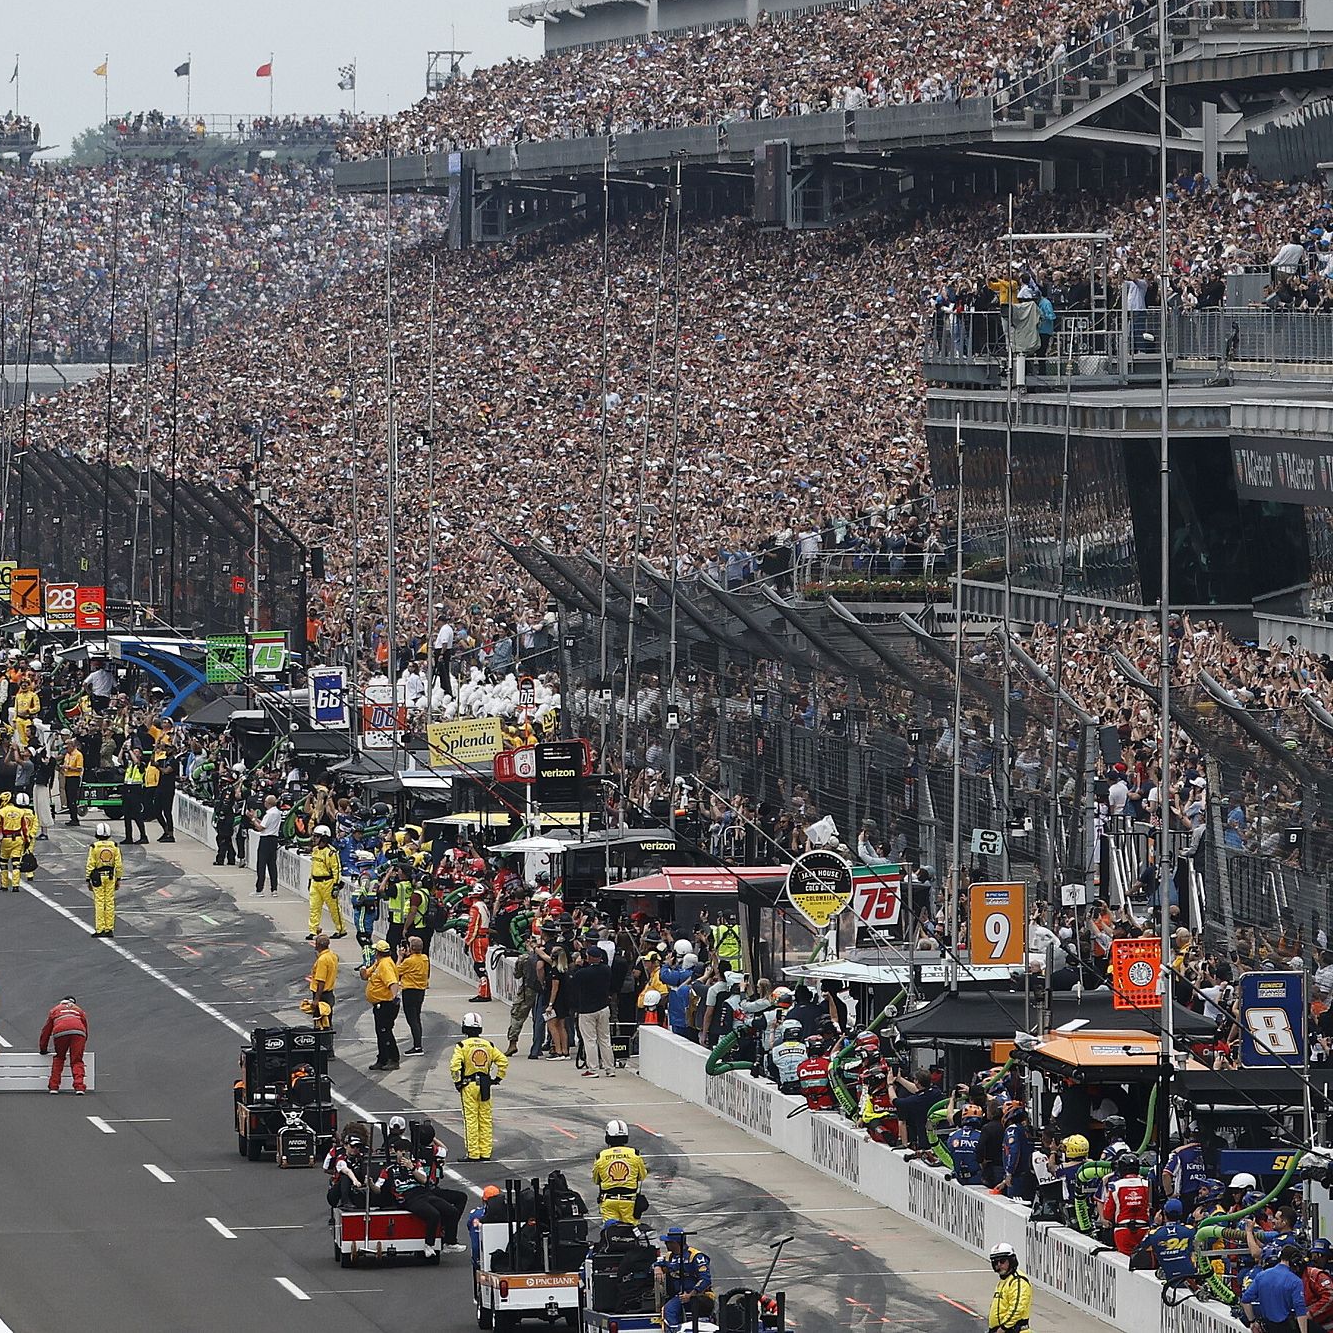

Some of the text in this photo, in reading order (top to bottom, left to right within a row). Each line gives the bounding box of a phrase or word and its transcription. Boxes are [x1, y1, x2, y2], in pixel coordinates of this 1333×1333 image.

[47, 588, 75, 610] 28
[937, 612, 990, 623] INDIAAPOLIS
[255, 646, 283, 668] 45
[317, 688, 341, 710] 66
[521, 688, 533, 704] 06
[439, 732, 495, 754] Splenda
[541, 768, 575, 778] verizon
[639, 841, 676, 851] verizon
[979, 830, 998, 854] 20
[818, 870, 840, 878] HOUSE
[860, 887, 898, 922] 75
[985, 912, 1011, 960] 9
[1245, 1008, 1300, 1056] 8
[799, 1068, 825, 1078] OMADA
[961, 1140, 979, 1148] PNC
[535, 1276, 575, 1286] PNC BANK
